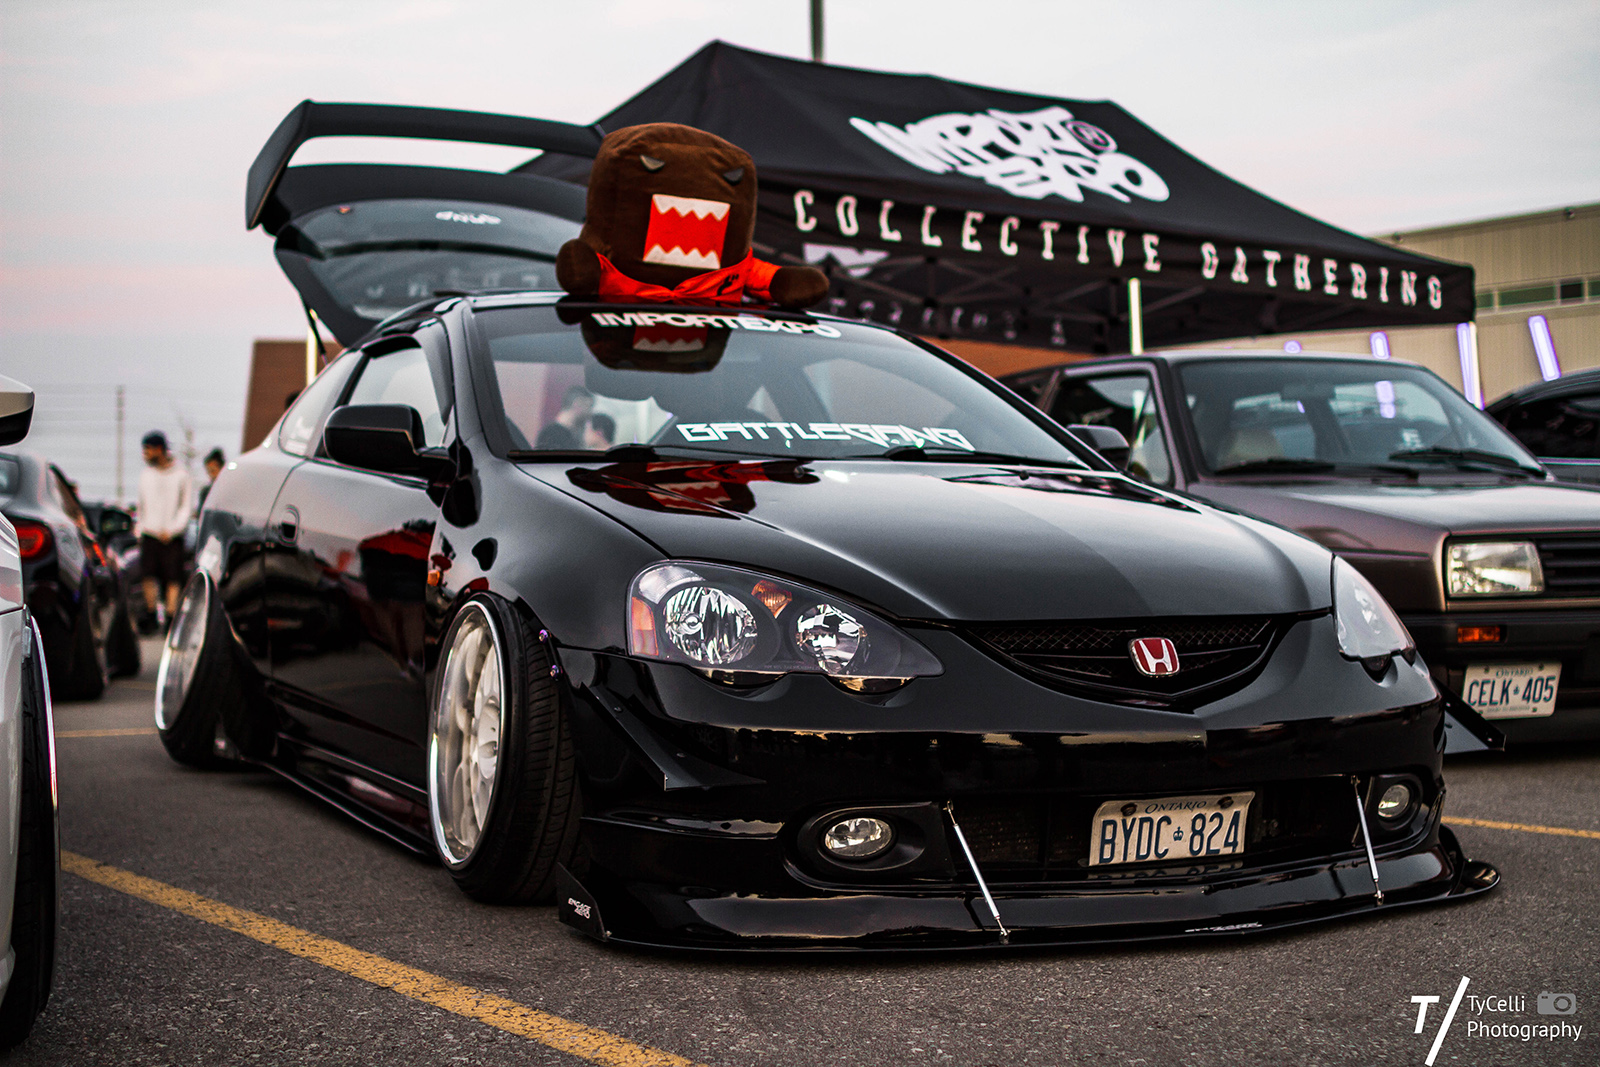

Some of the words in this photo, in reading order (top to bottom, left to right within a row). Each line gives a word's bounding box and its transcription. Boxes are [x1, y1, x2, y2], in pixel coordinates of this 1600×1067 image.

[984, 151, 1170, 202] EXPO
[793, 190, 1161, 271] COLLECTIVE
[1201, 243, 1442, 309] GATHERING
[676, 422, 976, 452] BATTLEGANG
[1467, 679, 1513, 707] CELK
[1522, 675, 1556, 704] 405
[1145, 801, 1207, 815] ONTARIO
[1100, 815, 1172, 864] BYDC
[1189, 810, 1241, 856] 824
